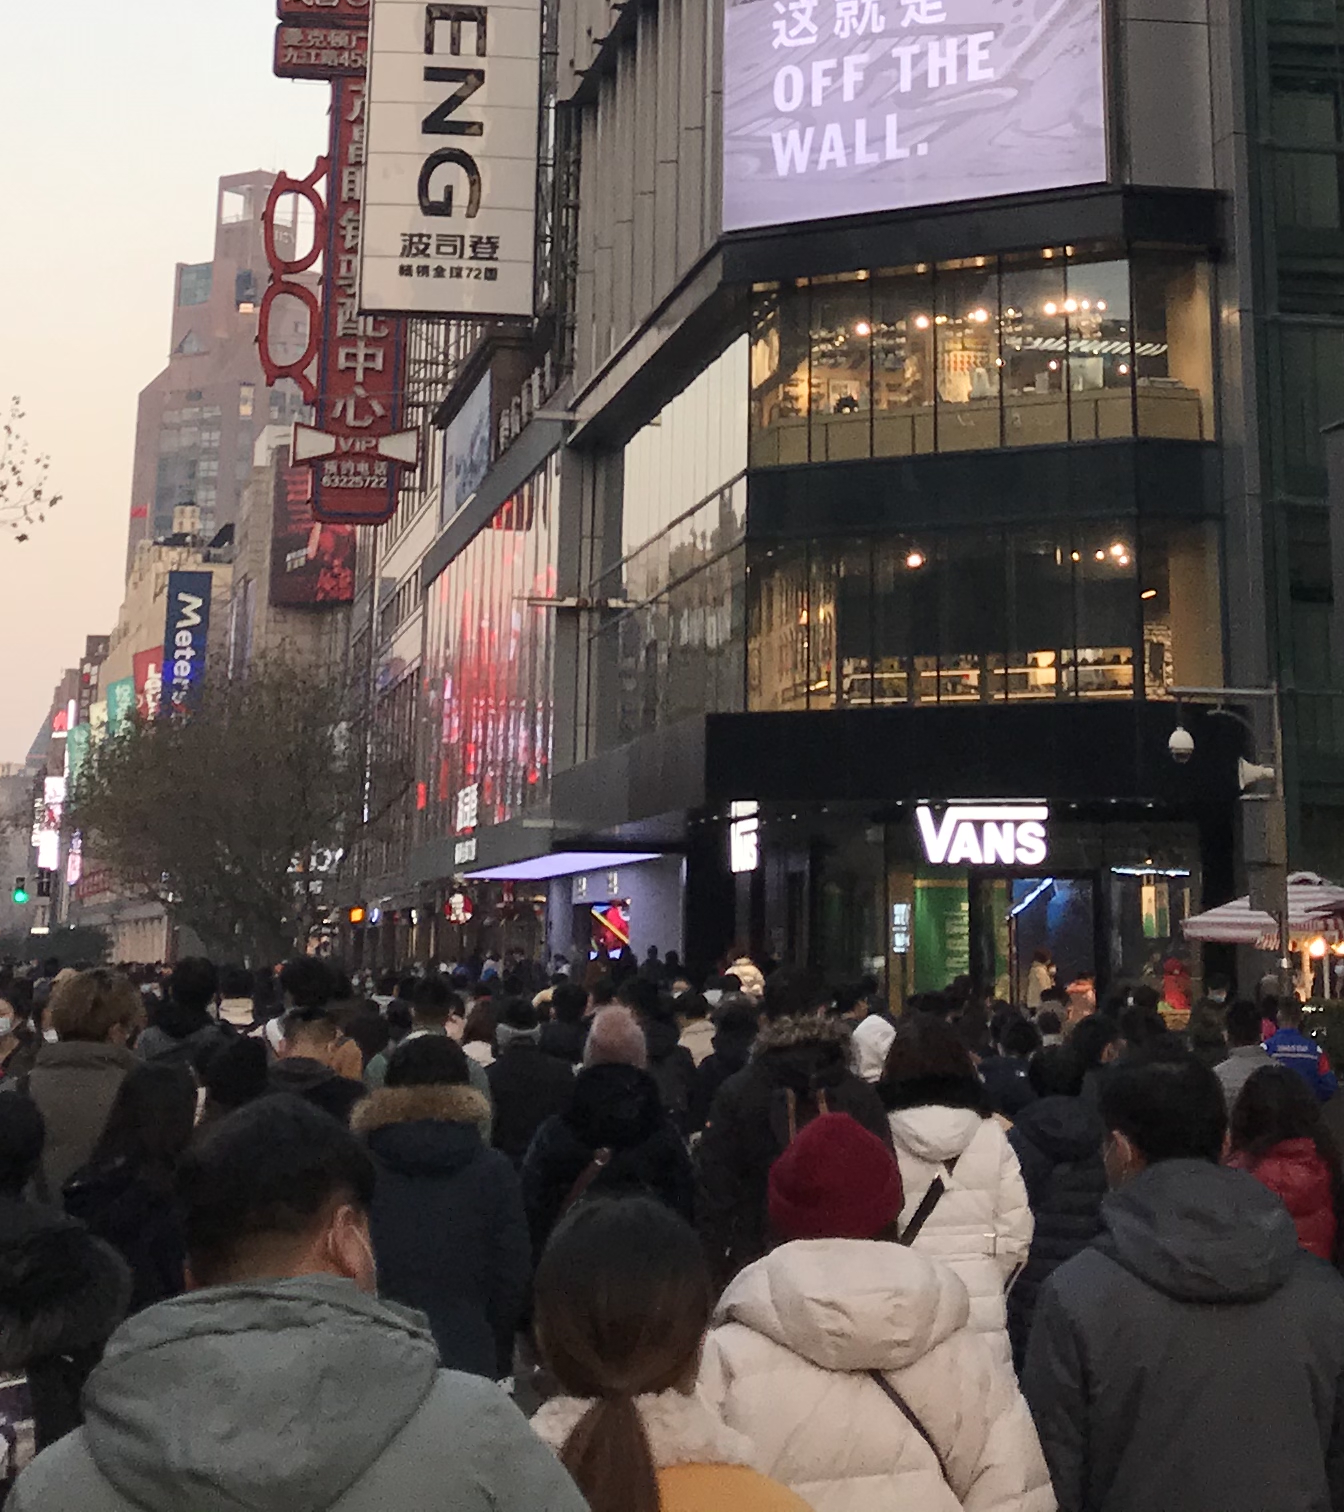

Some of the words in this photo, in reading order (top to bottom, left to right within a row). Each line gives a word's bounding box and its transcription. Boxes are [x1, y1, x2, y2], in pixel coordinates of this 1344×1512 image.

[773, 54, 868, 113] OFF
[892, 31, 995, 94] THE
[772, 114, 929, 177] WALL.
[399, 233, 500, 261] 波司登
[337, 437, 378, 453] VIP
[916, 805, 1049, 865] VANS
